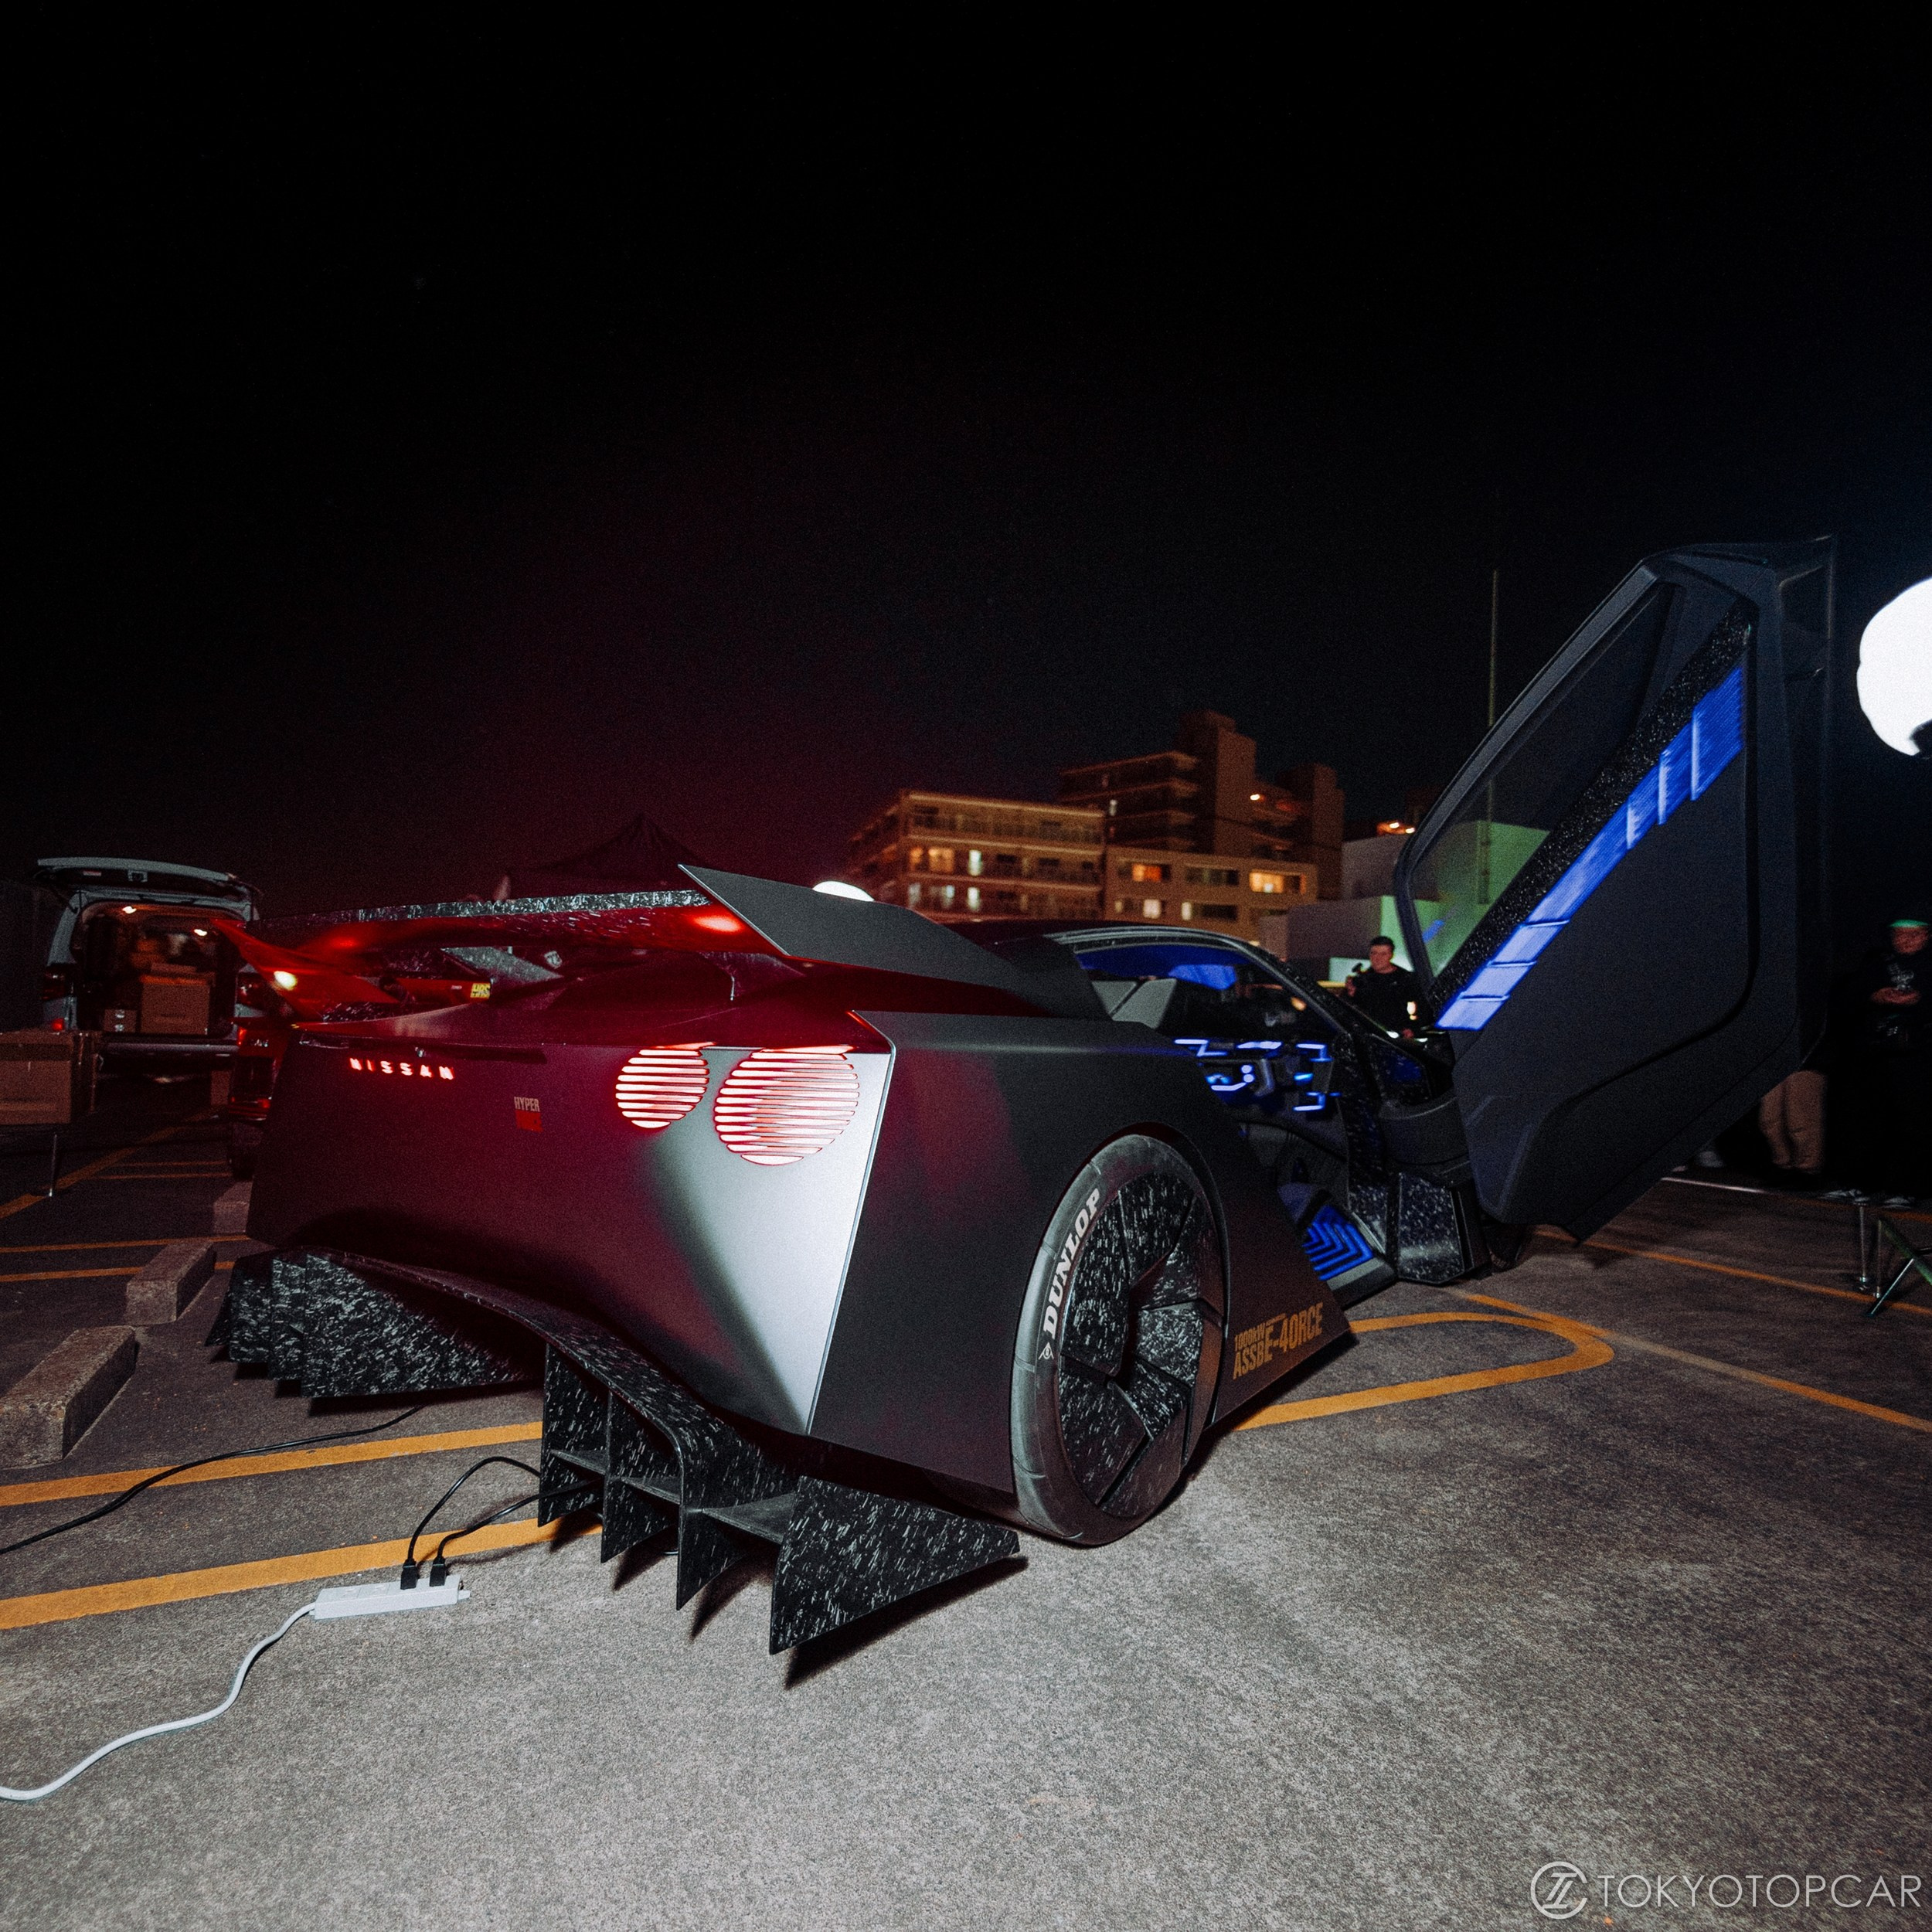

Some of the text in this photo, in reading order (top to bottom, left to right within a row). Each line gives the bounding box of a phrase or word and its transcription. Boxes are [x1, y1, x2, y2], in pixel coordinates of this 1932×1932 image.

[349, 1057, 454, 1080] NISSAN
[514, 1096, 540, 1112] HYPER
[1043, 1188, 1100, 1339] DUNLOP
